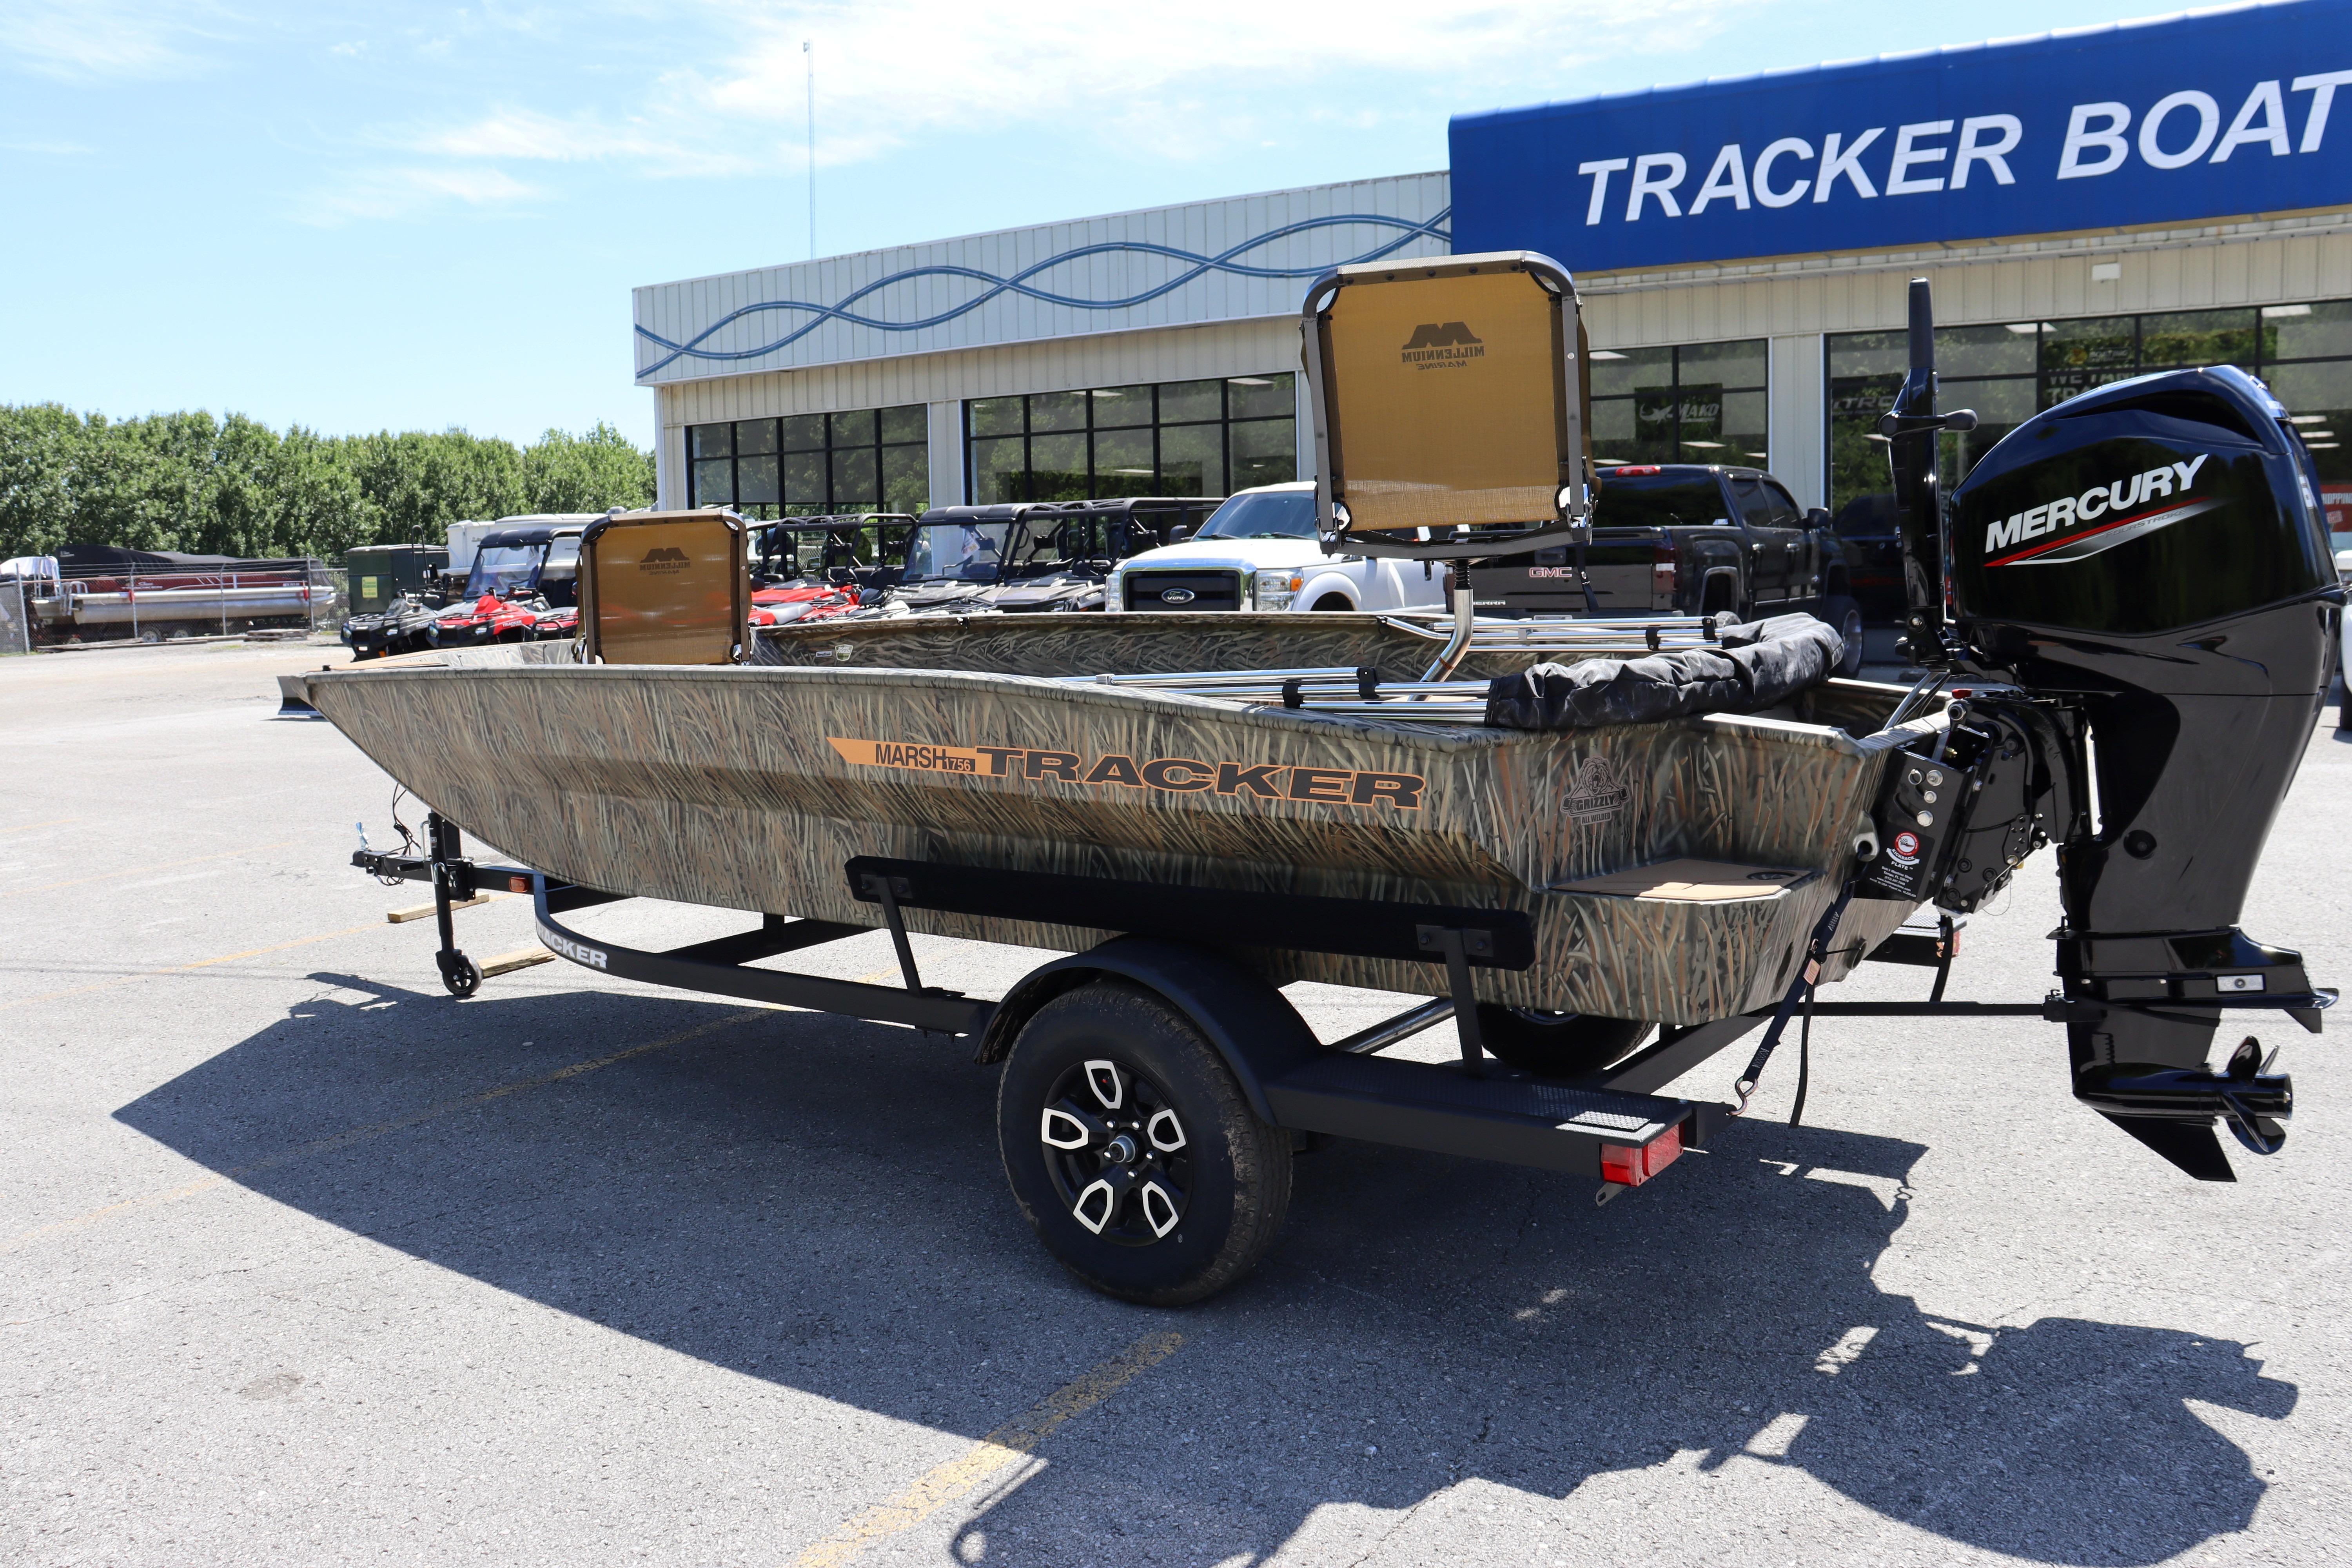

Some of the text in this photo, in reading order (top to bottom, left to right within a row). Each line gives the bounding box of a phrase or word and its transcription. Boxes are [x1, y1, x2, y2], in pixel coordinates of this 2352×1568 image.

[1578, 68, 2352, 226] TRACKER BOAT
[1985, 454, 2208, 553] MERCURY
[2105, 508, 2187, 538] FOURSTROKE
[1529, 567, 1572, 578] GMC
[1167, 591, 1185, 600] Ford
[876, 743, 1426, 809] MARSH 1756 TRACKER
[1576, 794, 1615, 811] GRIZZLY
[1591, 812, 1610, 822] WELDED
[1891, 849, 1915, 860] KICKBACK
[1891, 861, 1908, 870] PLATE
